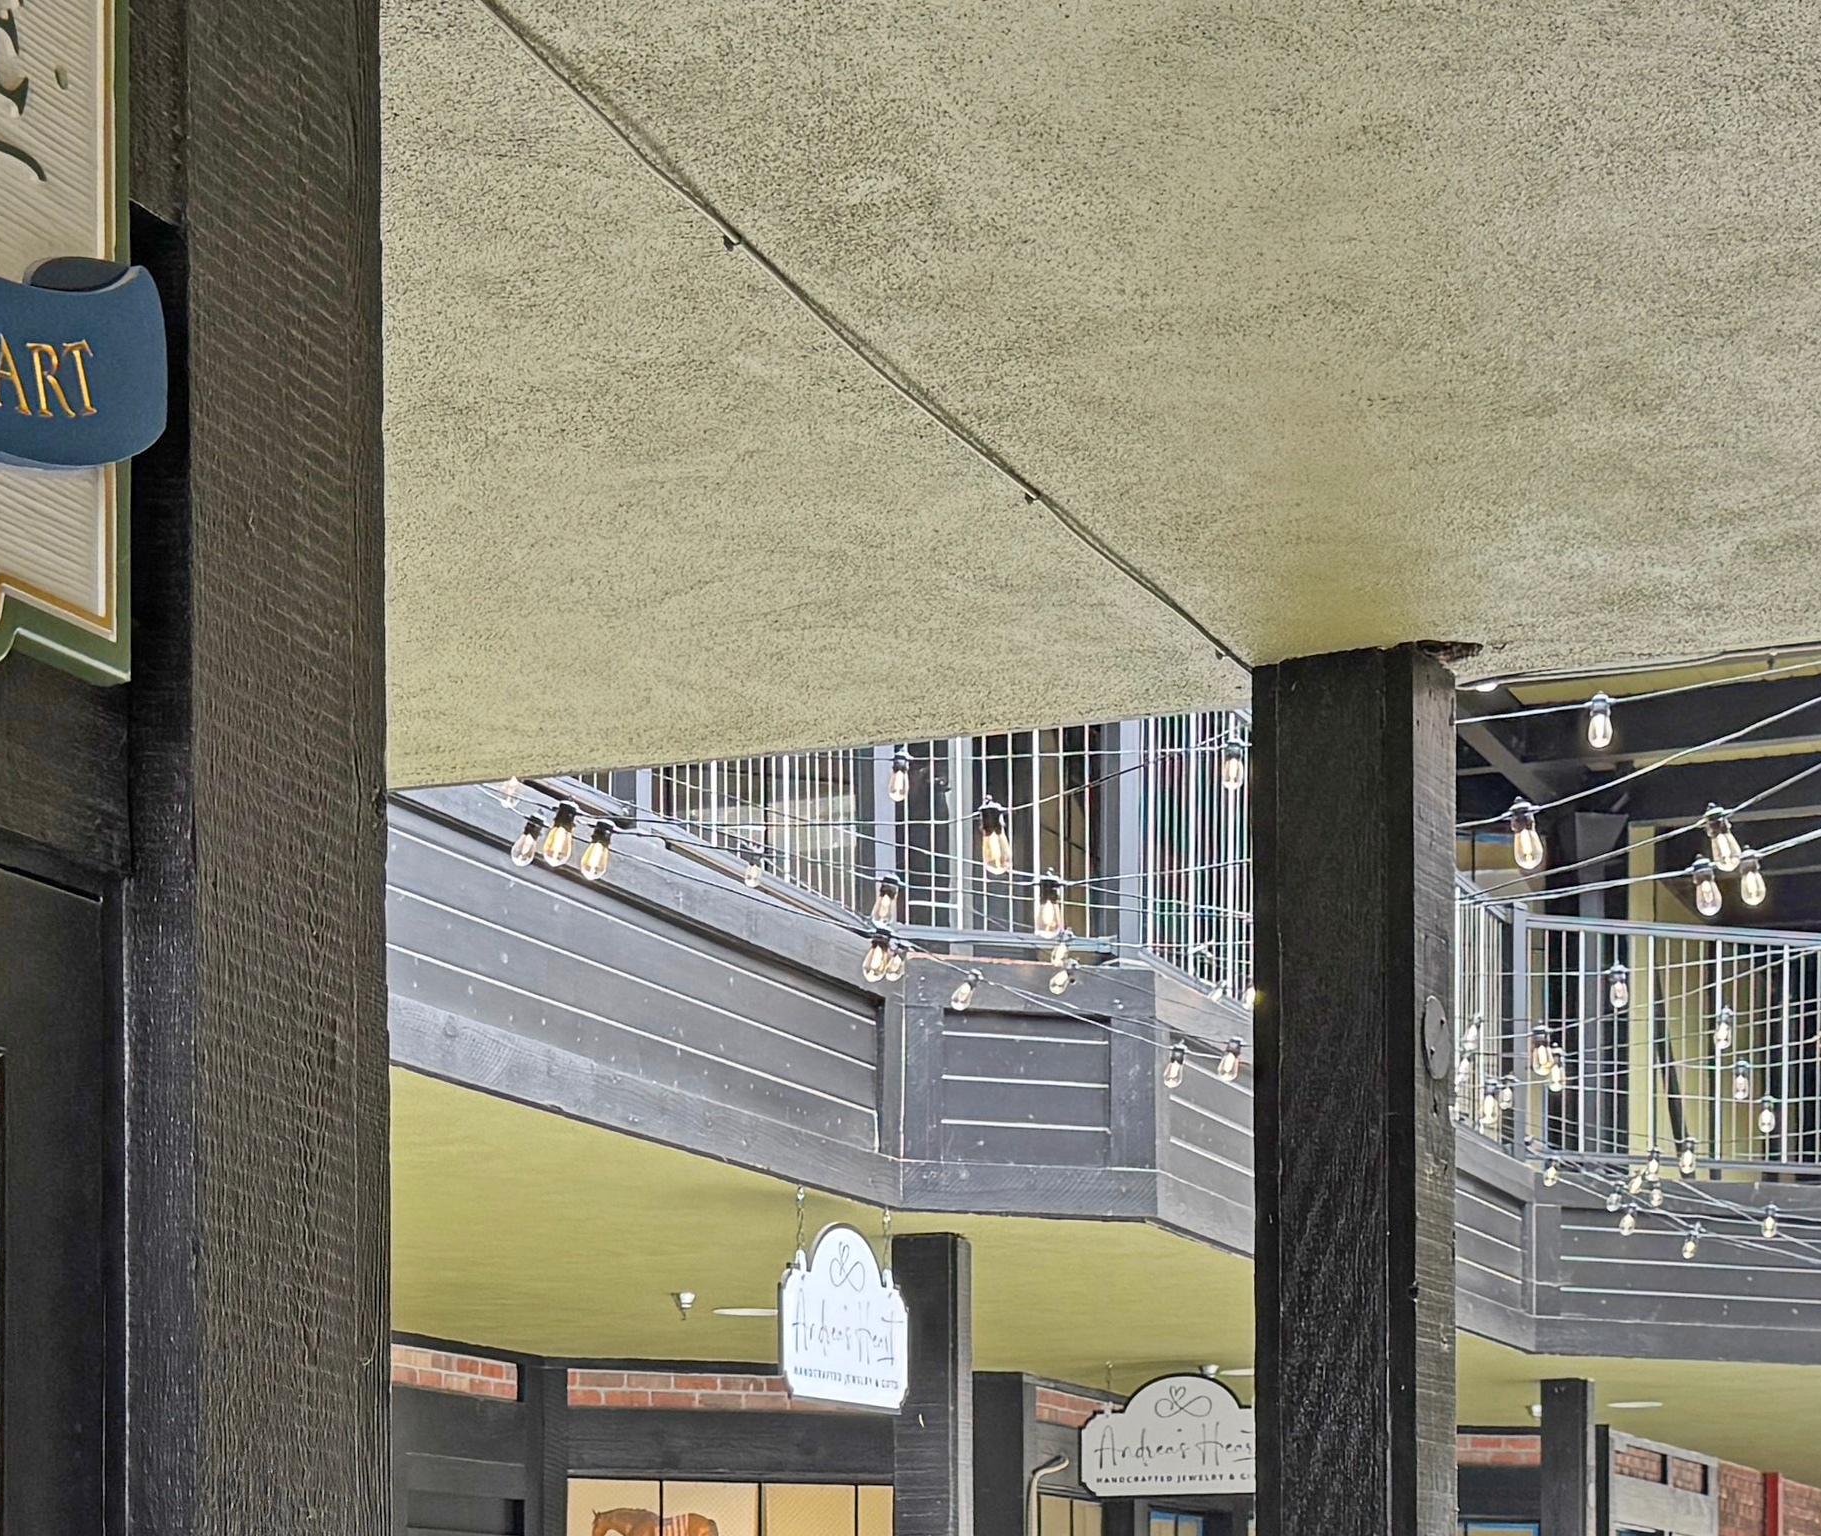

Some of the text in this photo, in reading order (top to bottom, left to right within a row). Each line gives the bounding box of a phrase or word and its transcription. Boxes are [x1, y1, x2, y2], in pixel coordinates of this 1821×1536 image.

[1094, 1425, 1189, 1469] Andrea's
[1096, 1475, 1173, 1485] HANDCRAFTED
[1177, 1473, 1224, 1484] JEWELRY
